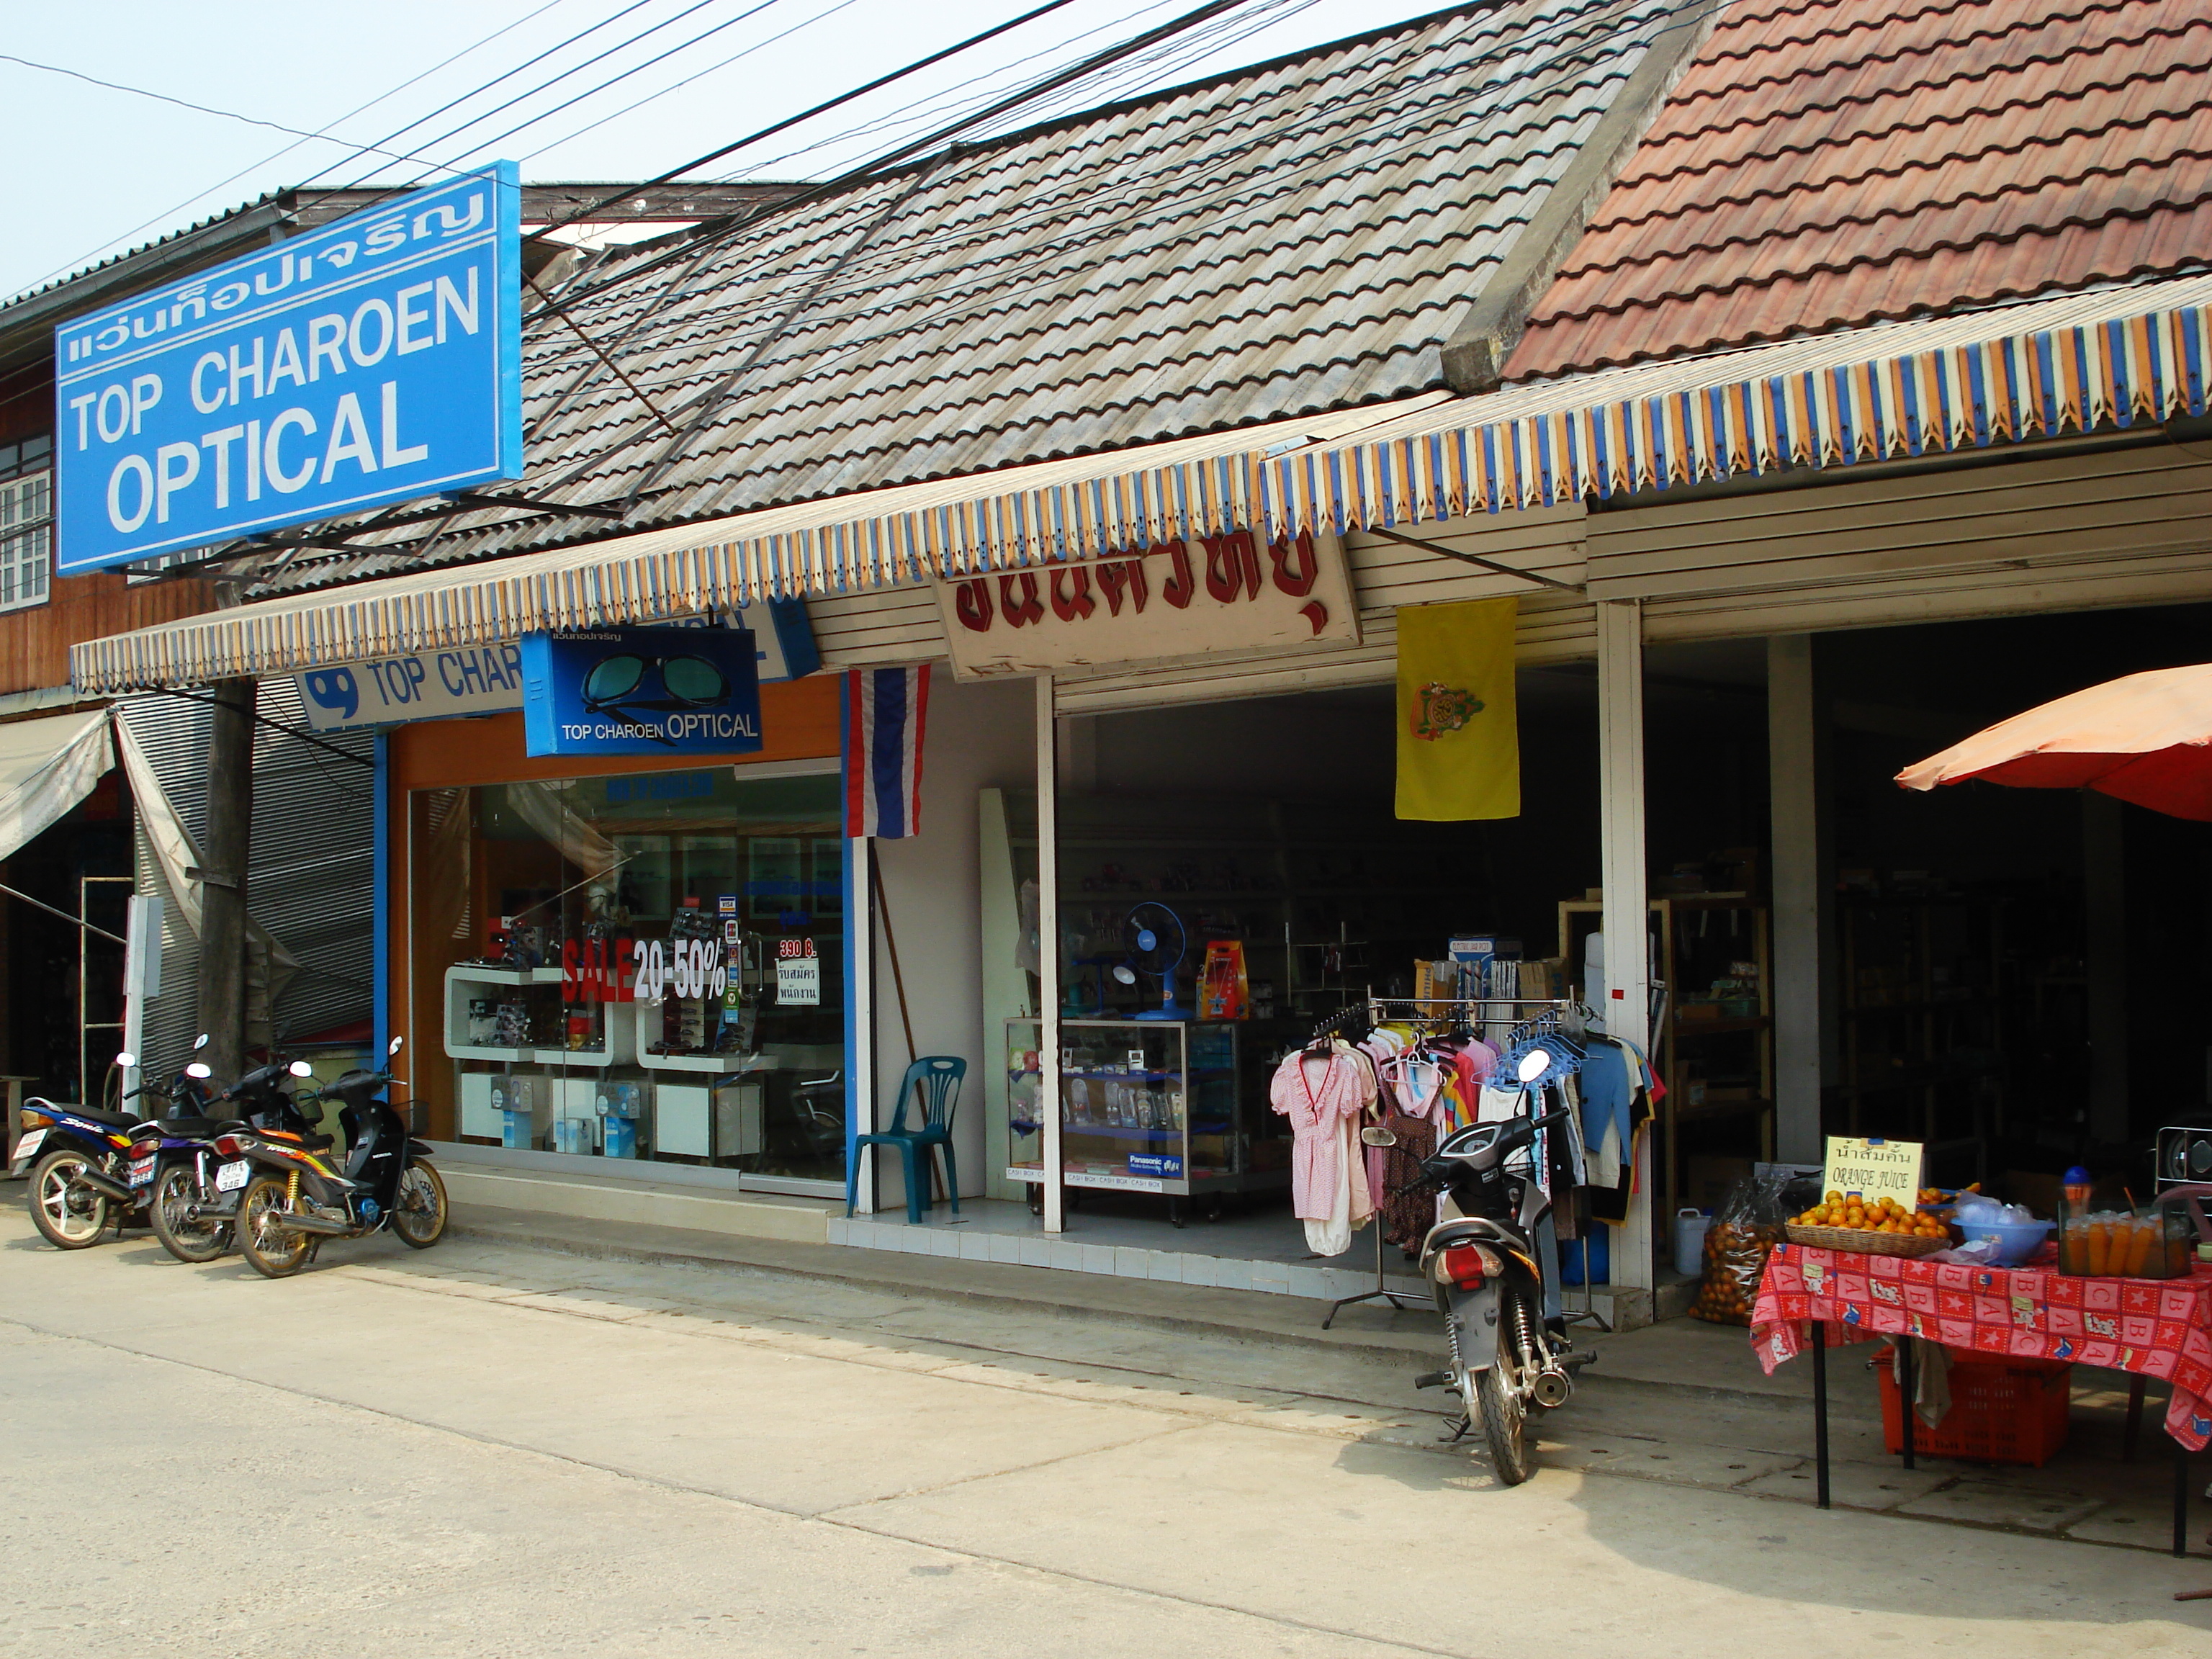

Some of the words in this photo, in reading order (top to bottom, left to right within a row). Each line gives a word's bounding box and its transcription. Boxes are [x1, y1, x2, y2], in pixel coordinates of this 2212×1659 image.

[68, 192, 485, 363] แว่นท็อปเจริญ
[70, 372, 163, 452] TOP
[190, 265, 480, 415] CHAROEN
[107, 379, 429, 534] OPTICAL
[366, 657, 426, 706] TOP
[437, 644, 523, 697] CHAR
[562, 724, 592, 740] TOP
[595, 723, 664, 739] CHAROEN
[667, 713, 758, 739] OPTICAL
[780, 940, 801, 957] 390
[562, 938, 634, 1002] SALE
[634, 938, 726, 1000] 20-50%
[778, 965, 816, 979] รับสมัคร
[780, 984, 817, 999] พนักงาน
[60, 1117, 105, 1133] Sonic
[1130, 1154, 1162, 1166] Panasonic
[1836, 1139, 1911, 1164] น้ำส้มคั้น
[221, 1179, 240, 1190] 346
[1833, 1166, 1875, 1190] ORANGE
[1877, 1169, 1910, 1190] JUICE
